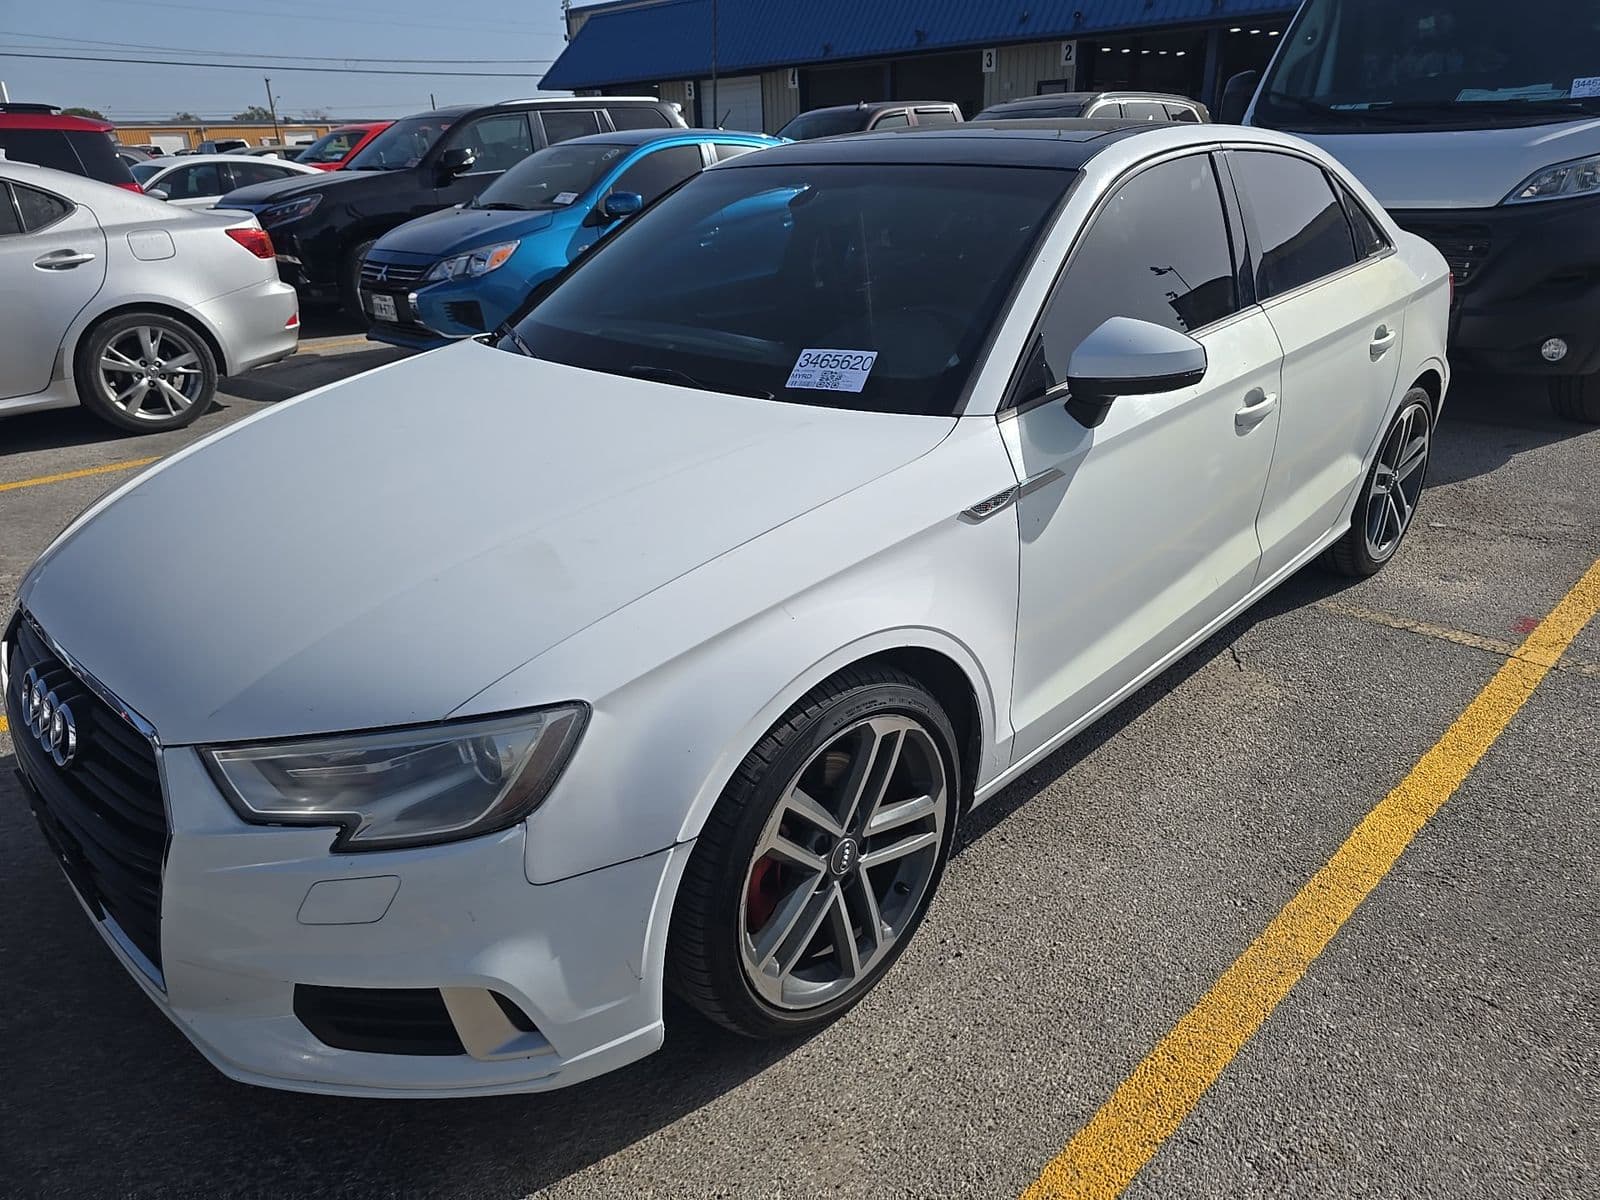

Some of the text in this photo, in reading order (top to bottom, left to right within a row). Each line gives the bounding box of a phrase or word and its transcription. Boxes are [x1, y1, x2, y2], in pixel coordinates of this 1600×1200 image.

[986, 52, 992, 68] 3
[1065, 44, 1072, 61] 2
[790, 67, 796, 85] 4
[687, 83, 693, 97] 5
[799, 353, 874, 372] 3465620
